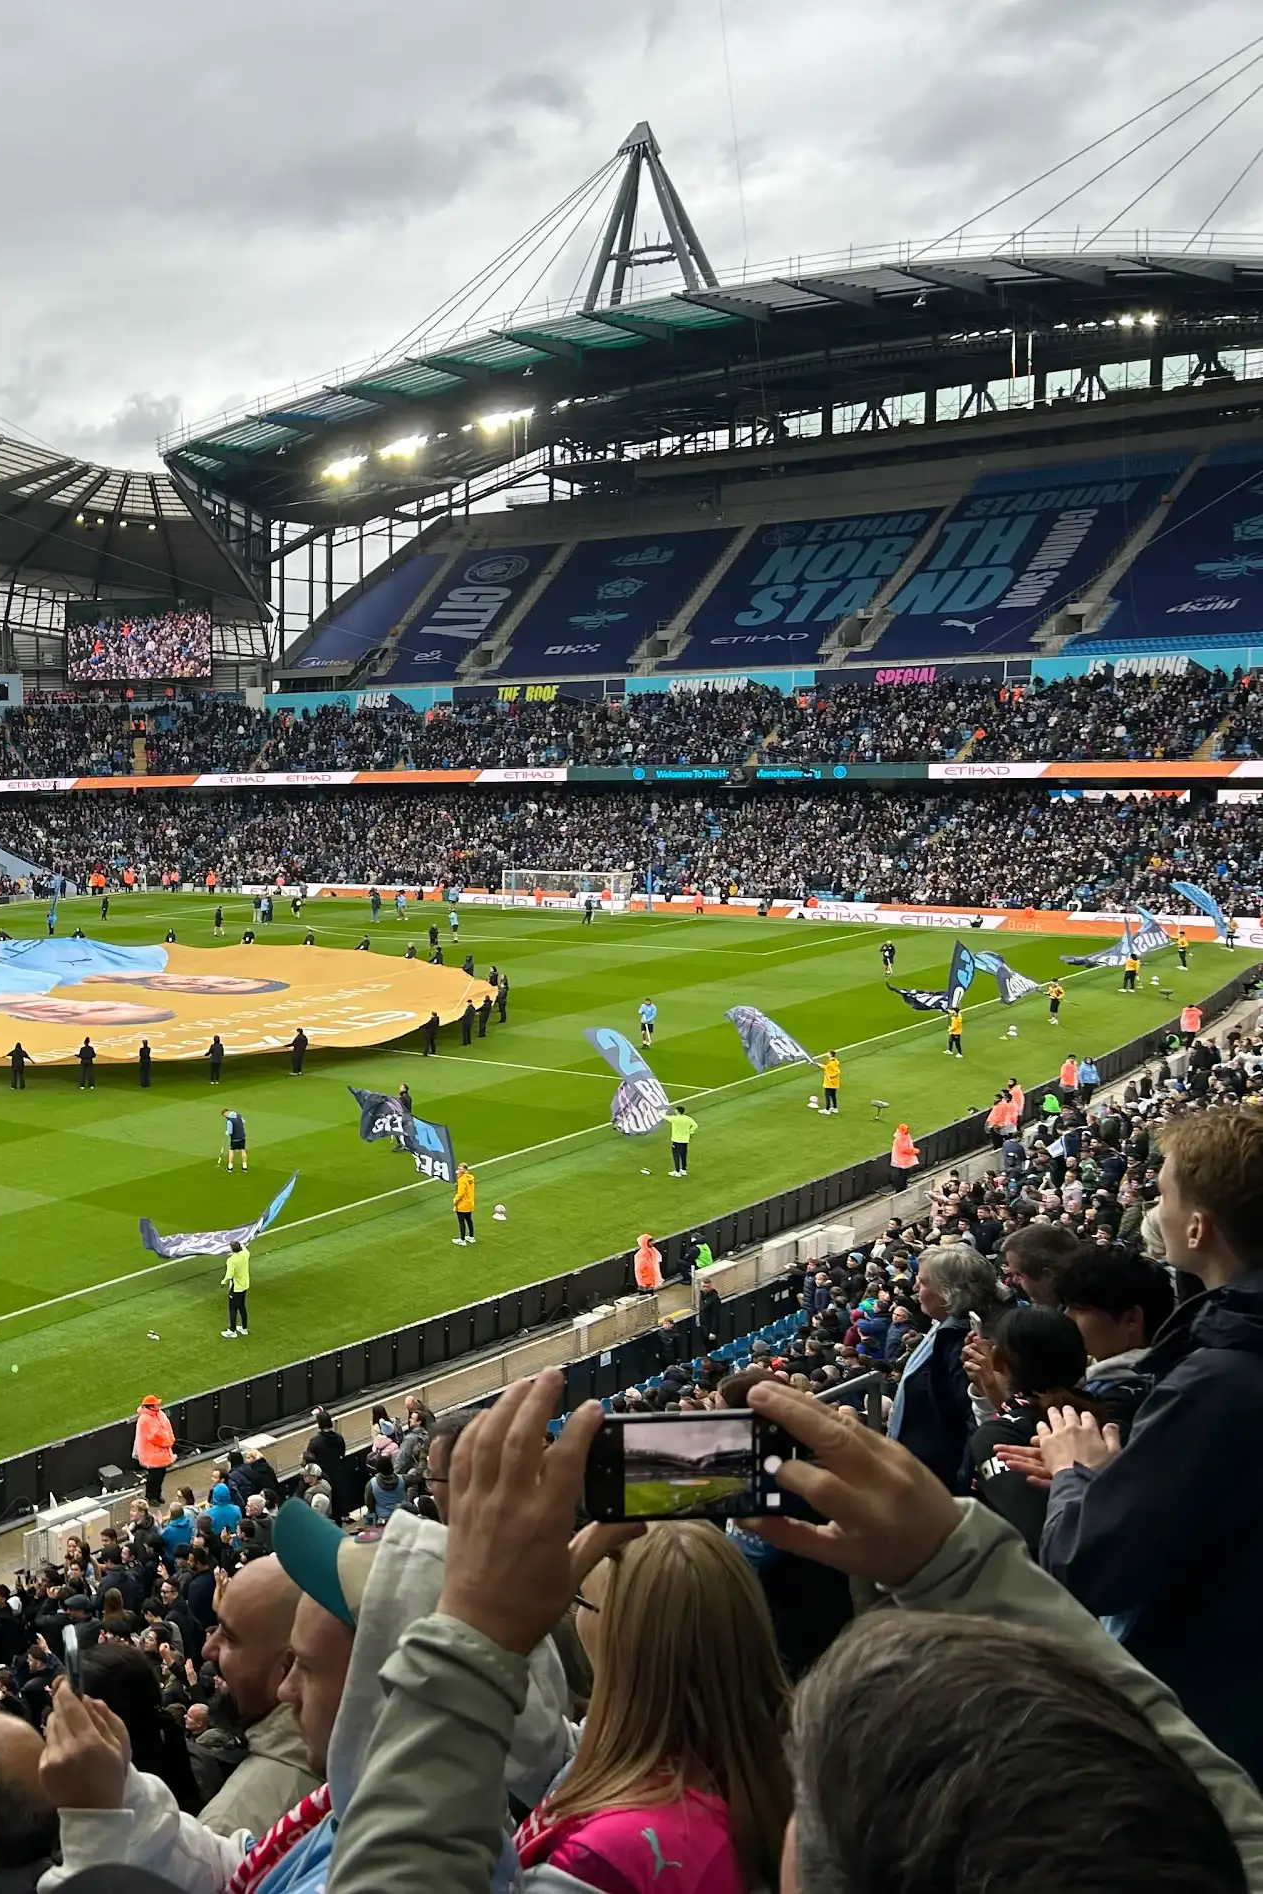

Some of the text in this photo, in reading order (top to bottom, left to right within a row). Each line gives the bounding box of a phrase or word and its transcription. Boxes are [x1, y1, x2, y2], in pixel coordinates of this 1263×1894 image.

[964, 482, 1140, 518] STADIUM
[805, 513, 928, 543] ETIHAD
[750, 513, 1039, 586] NORTH
[996, 508, 1099, 609] COMING SOON
[419, 586, 512, 640] CITY
[1165, 597, 1242, 614] Asahi
[710, 632, 810, 645] ETIHAD
[544, 643, 602, 656] OKX
[1088, 656, 1189, 678] IS COMING
[874, 666, 937, 686] SPECIAL
[497, 684, 560, 703] THE ROOF
[668, 676, 748, 696] SOMETHING
[355, 692, 390, 709] RAISE
[285, 774, 332, 783] ETIHAD
[503, 771, 555, 780] ETIHAD
[655, 769, 694, 779] Welcome
[943, 765, 1011, 776] ETIHAD
[219, 775, 266, 784] ETIHAD
[811, 911, 879, 923] ETIHAD
[900, 915, 972, 928] ETIHAD
[980, 1456, 1011, 1481] OK
